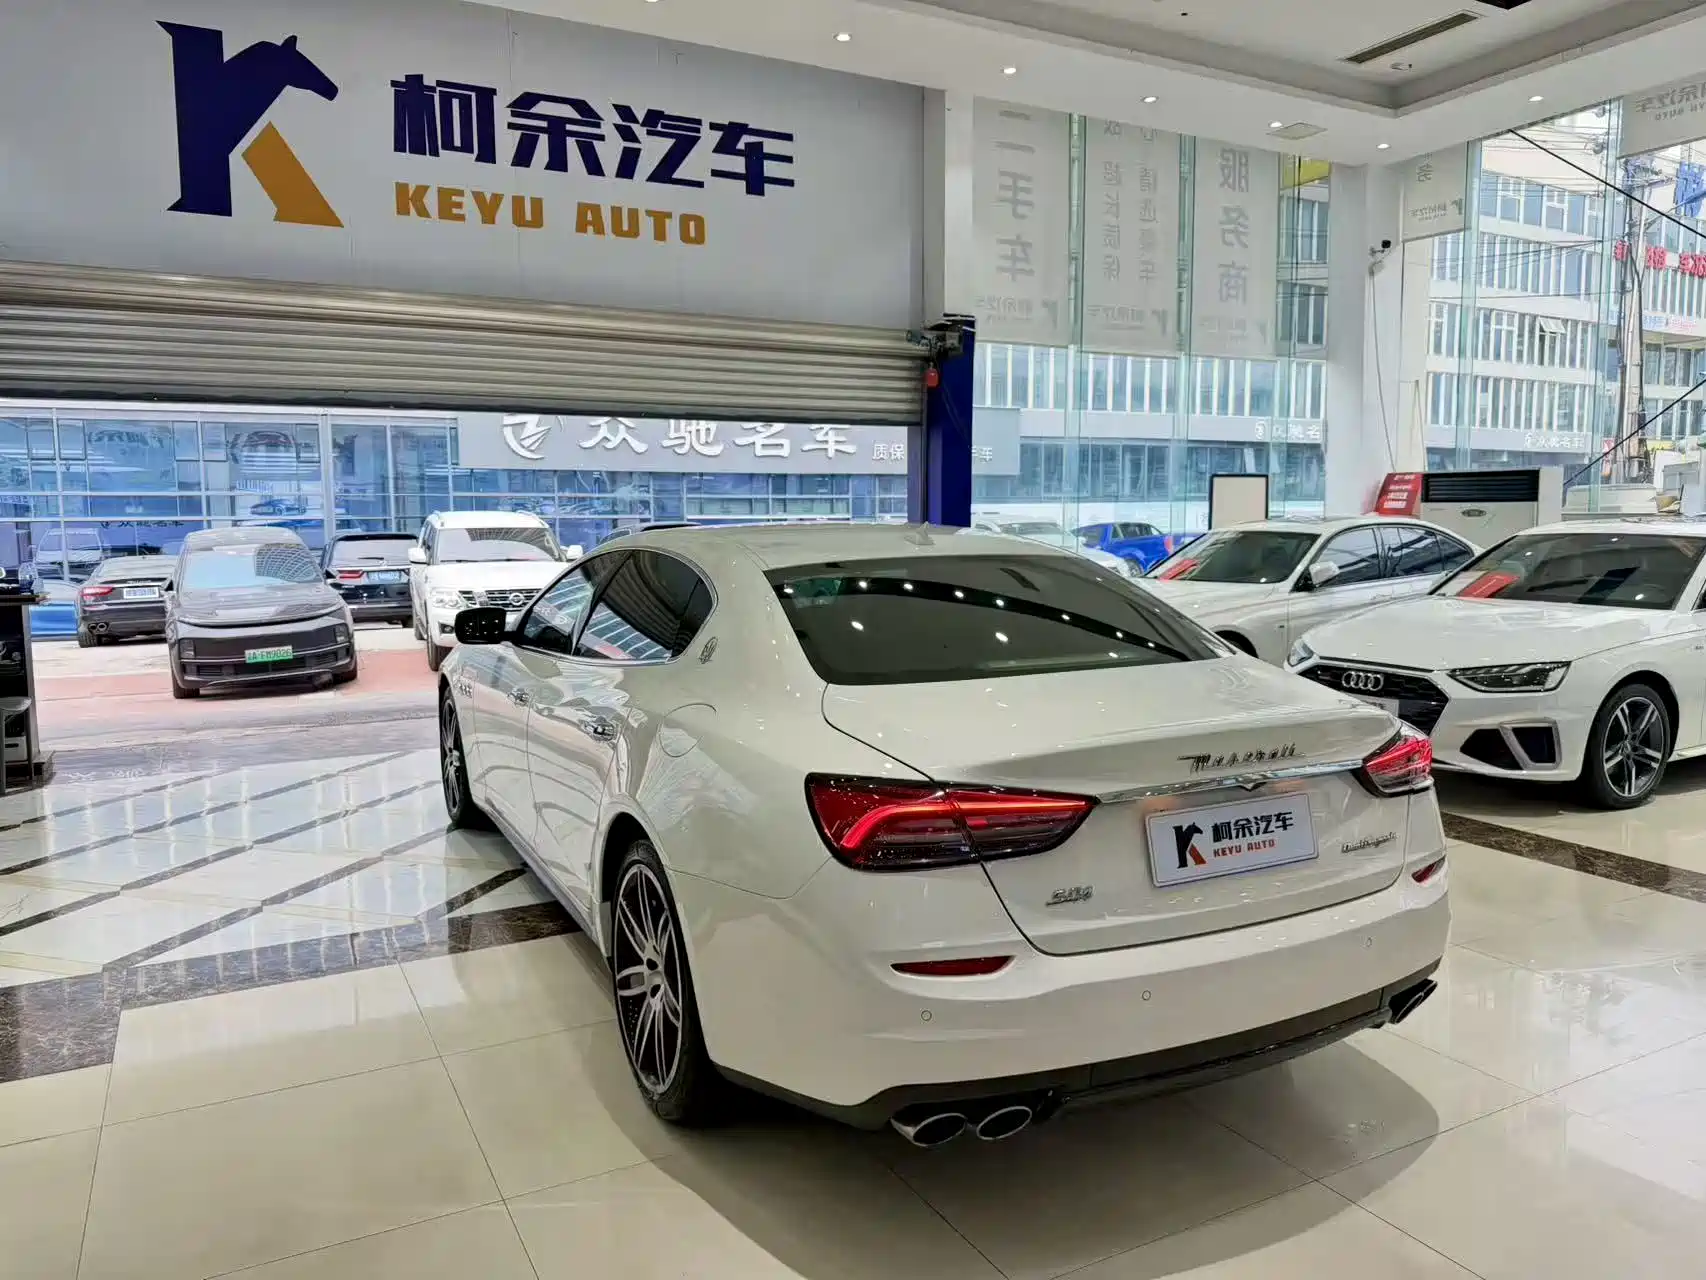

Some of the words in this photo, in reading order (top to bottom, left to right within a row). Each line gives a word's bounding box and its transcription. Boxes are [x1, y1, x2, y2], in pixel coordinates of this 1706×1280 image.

[391, 74, 794, 197] 柯余汽车
[395, 183, 542, 229] KEYU
[577, 202, 706, 245] AUTO
[577, 416, 857, 459] 众驰名车
[871, 443, 905, 462] 质保
[1212, 811, 1294, 843] 柯余汽车
[1213, 847, 1242, 858] KEYU
[1247, 839, 1276, 852] AUTO
